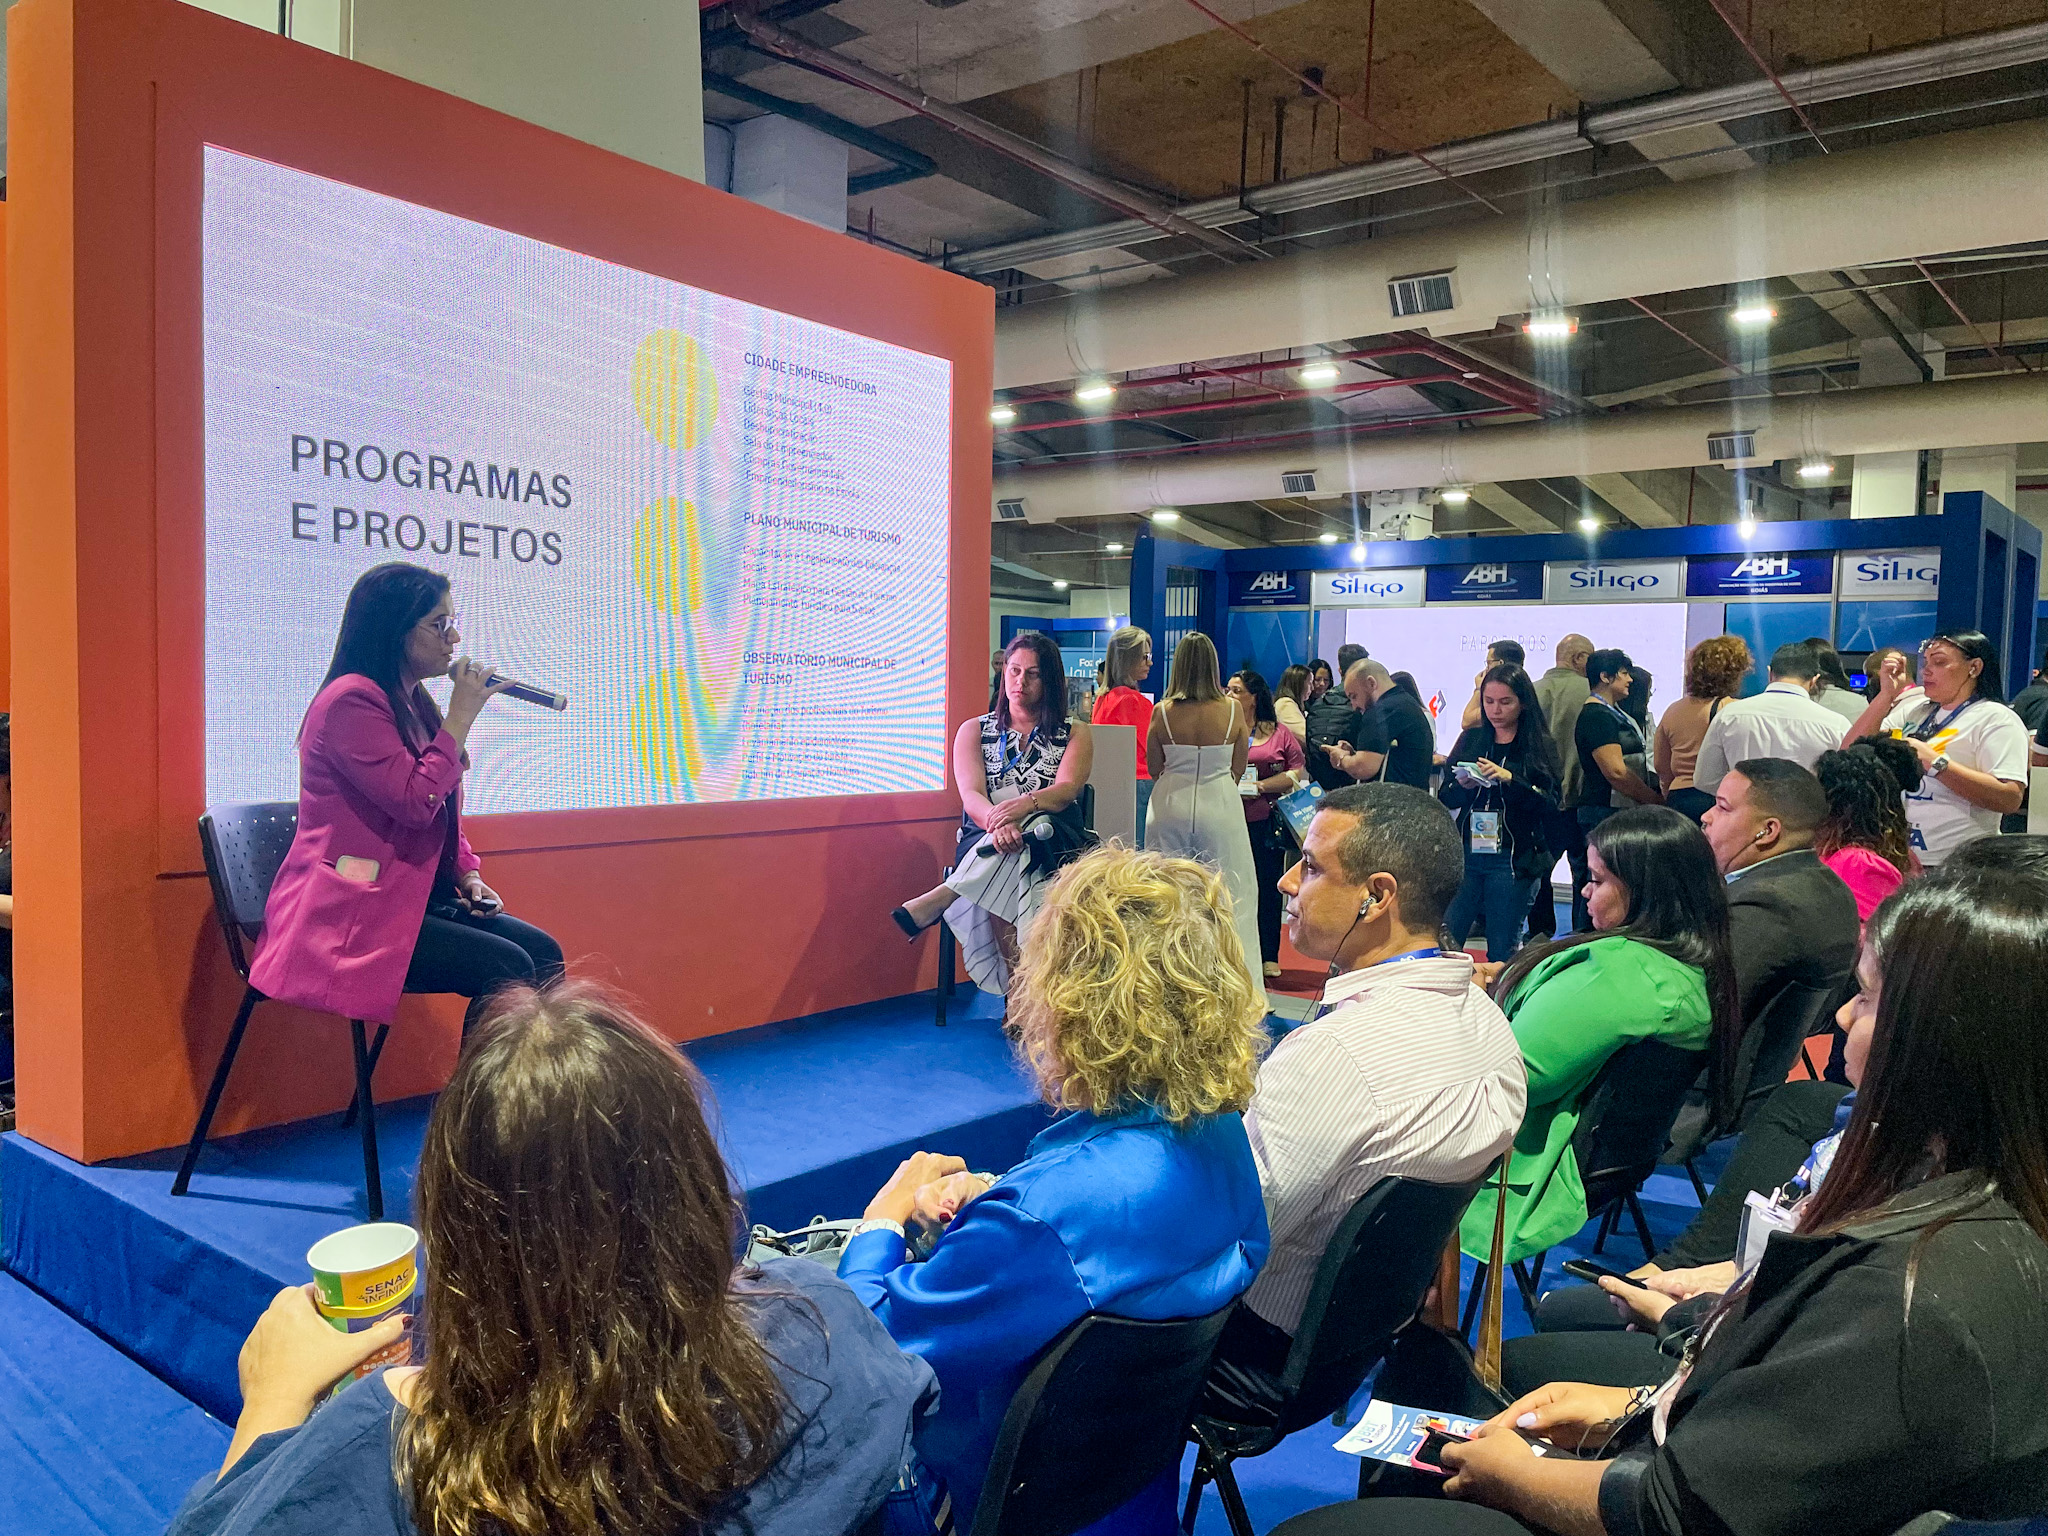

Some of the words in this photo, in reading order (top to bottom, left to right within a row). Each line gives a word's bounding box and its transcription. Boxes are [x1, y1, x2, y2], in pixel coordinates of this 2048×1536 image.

[744, 352, 786, 374] CIDADE
[788, 363, 878, 397] EMPREENDEDORA
[290, 433, 572, 508] PROGRAMAS
[291, 501, 318, 541] E
[333, 506, 563, 567] PROJETOS
[744, 512, 780, 528] PLANO
[783, 517, 842, 537] MUNICIPAL
[843, 526, 857, 539] DE
[858, 528, 902, 546] TURISMO
[1461, 563, 1508, 585] ABH
[1730, 552, 1789, 577] ABH
[1249, 571, 1288, 591] ABH
[743, 651, 826, 668] OBSERVATÓRIO
[828, 655, 883, 670] MUNICIPAL
[884, 658, 896, 670] DE
[743, 673, 793, 685] TURISMO
[365, 1268, 409, 1295] SENAC
